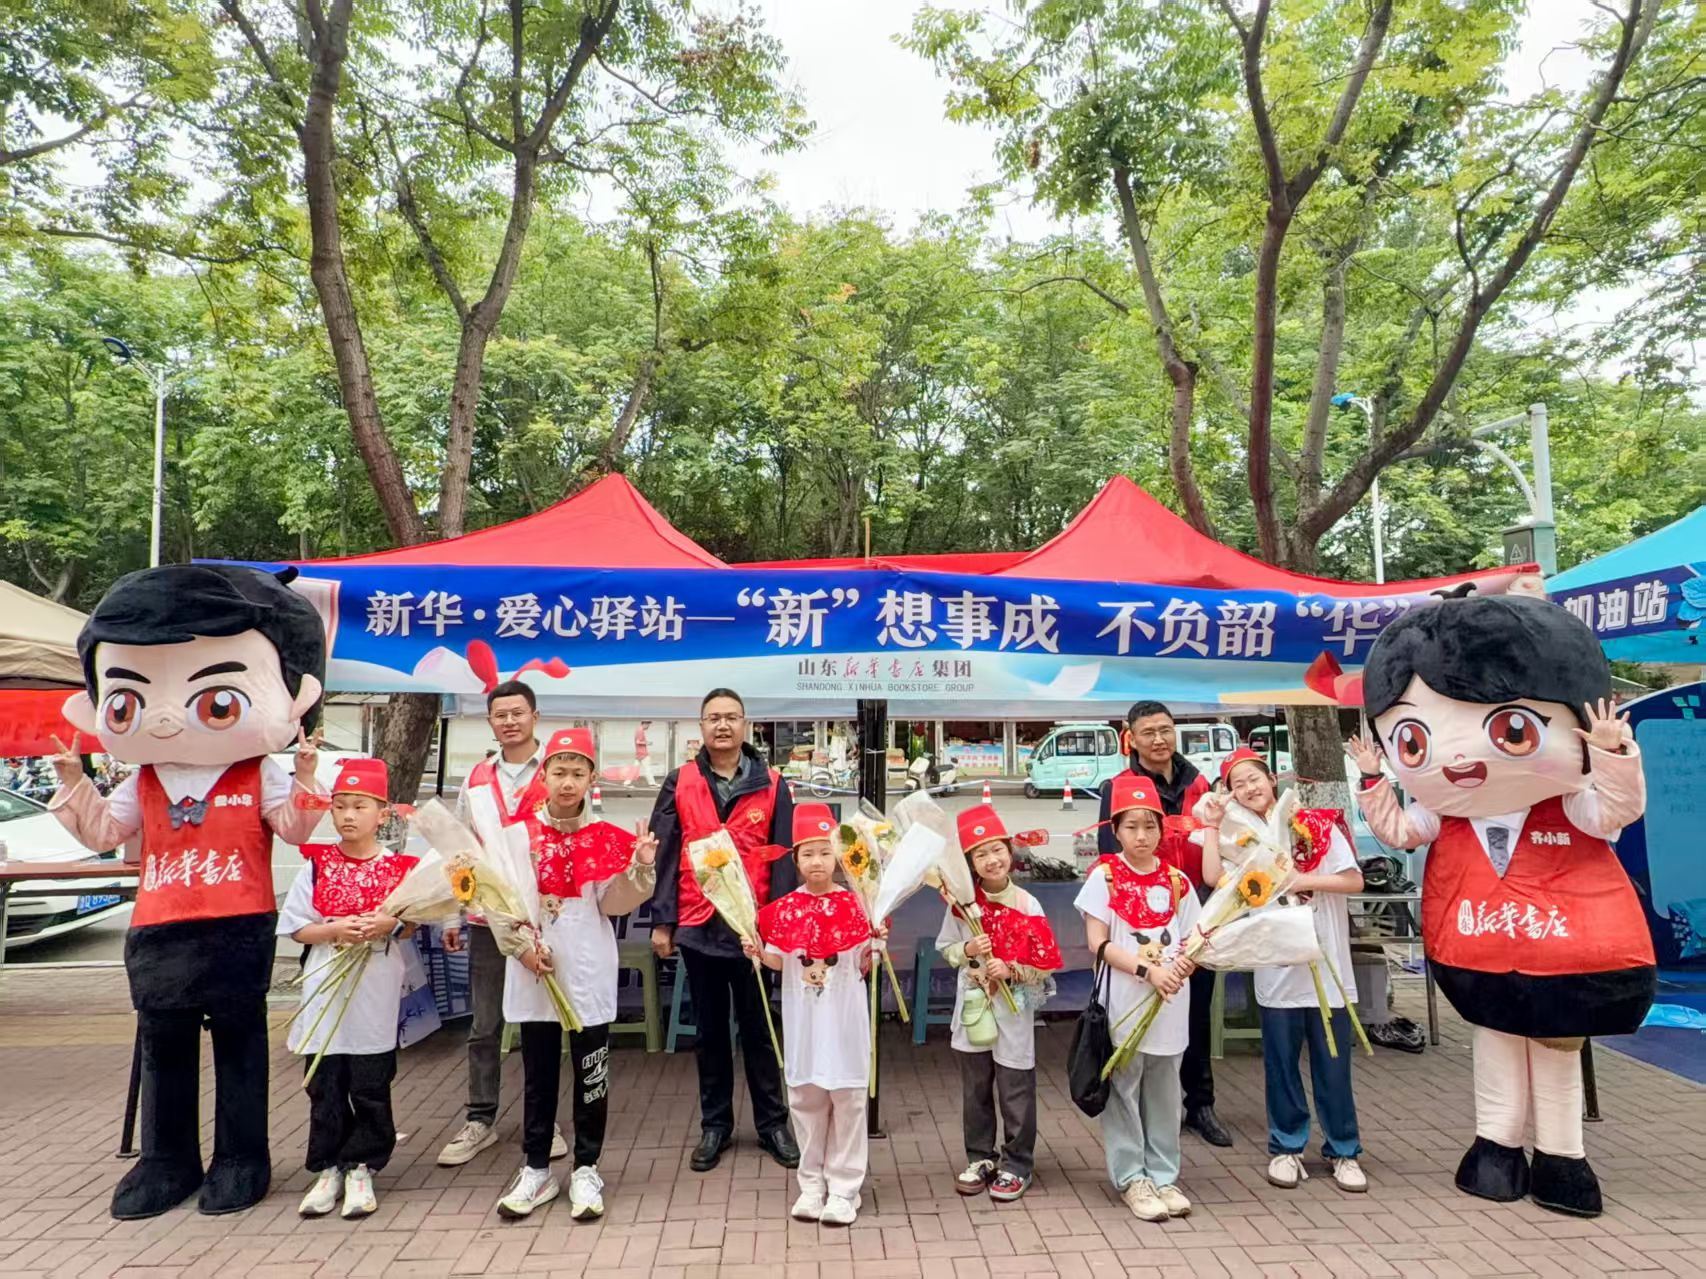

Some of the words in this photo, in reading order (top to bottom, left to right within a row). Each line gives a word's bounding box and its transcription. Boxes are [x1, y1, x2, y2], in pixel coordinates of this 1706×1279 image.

[797, 682, 842, 691] SHANDONG
[849, 682, 882, 692] XINHUA
[888, 682, 938, 691] BOOKSTORE
[945, 682, 974, 691] GROUP
